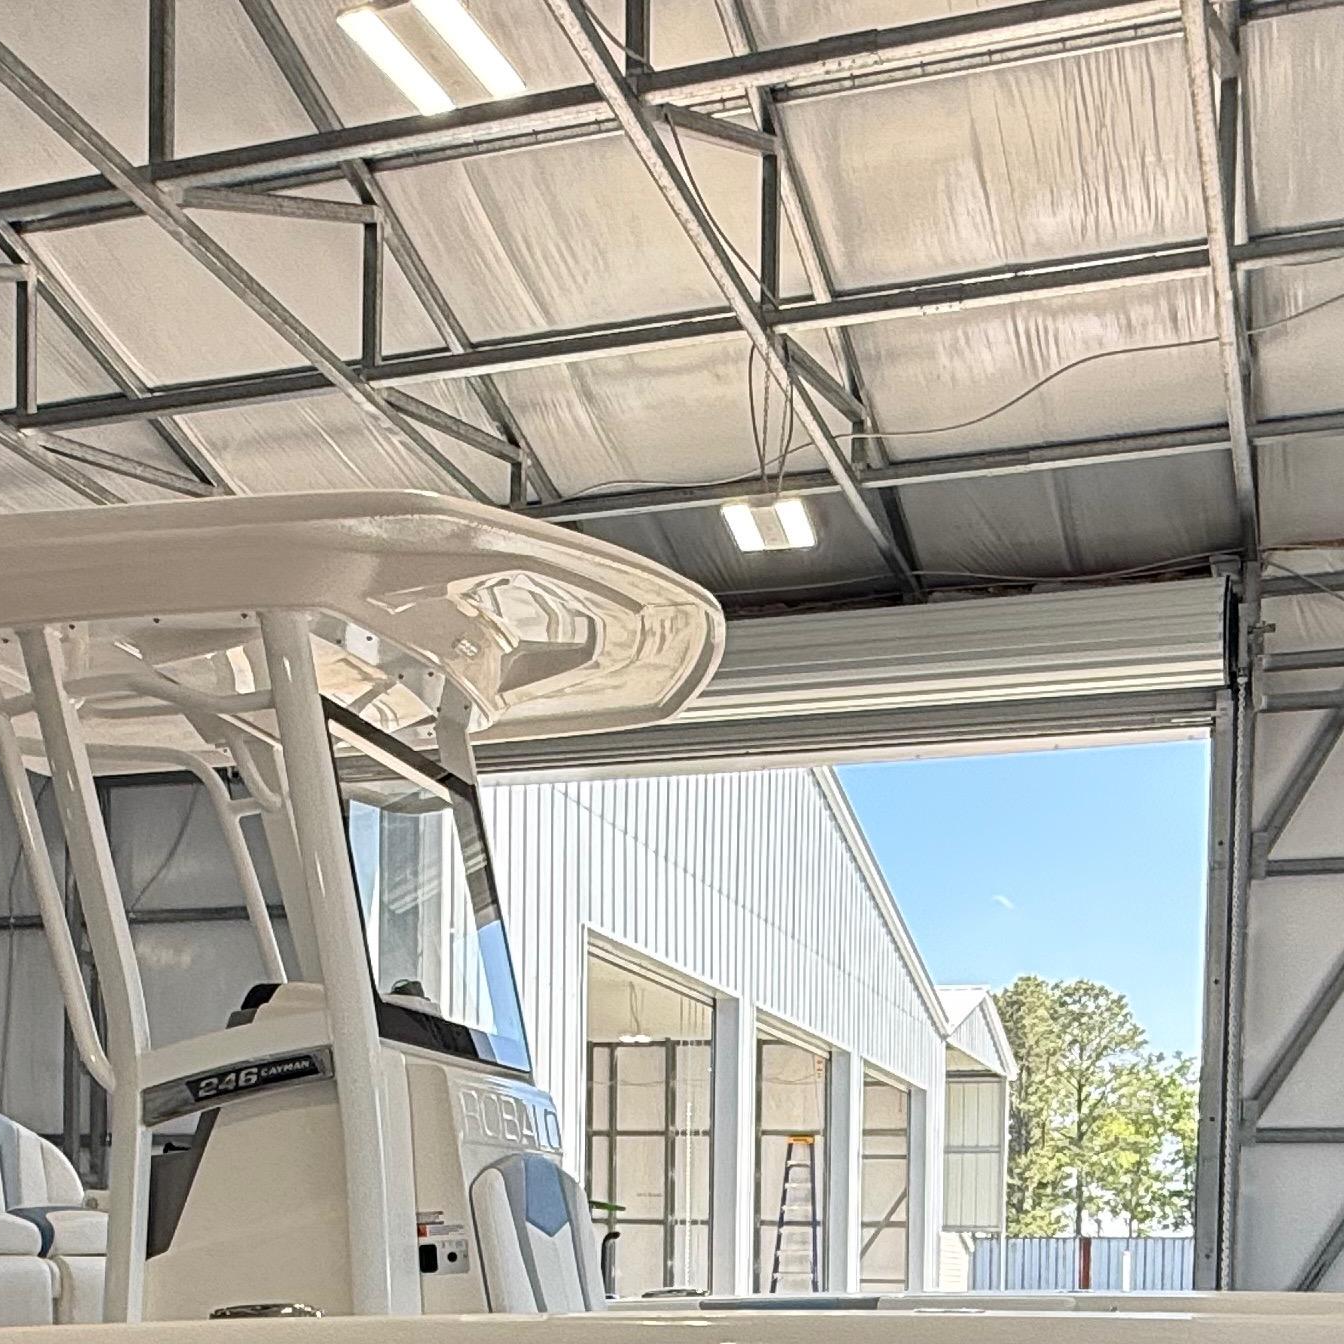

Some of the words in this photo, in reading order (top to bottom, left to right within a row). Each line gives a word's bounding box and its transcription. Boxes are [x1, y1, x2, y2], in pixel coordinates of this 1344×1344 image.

[198, 1068, 258, 1098] 246
[260, 1060, 310, 1077] CAYMAN
[459, 1089, 563, 1150] ROBALO
